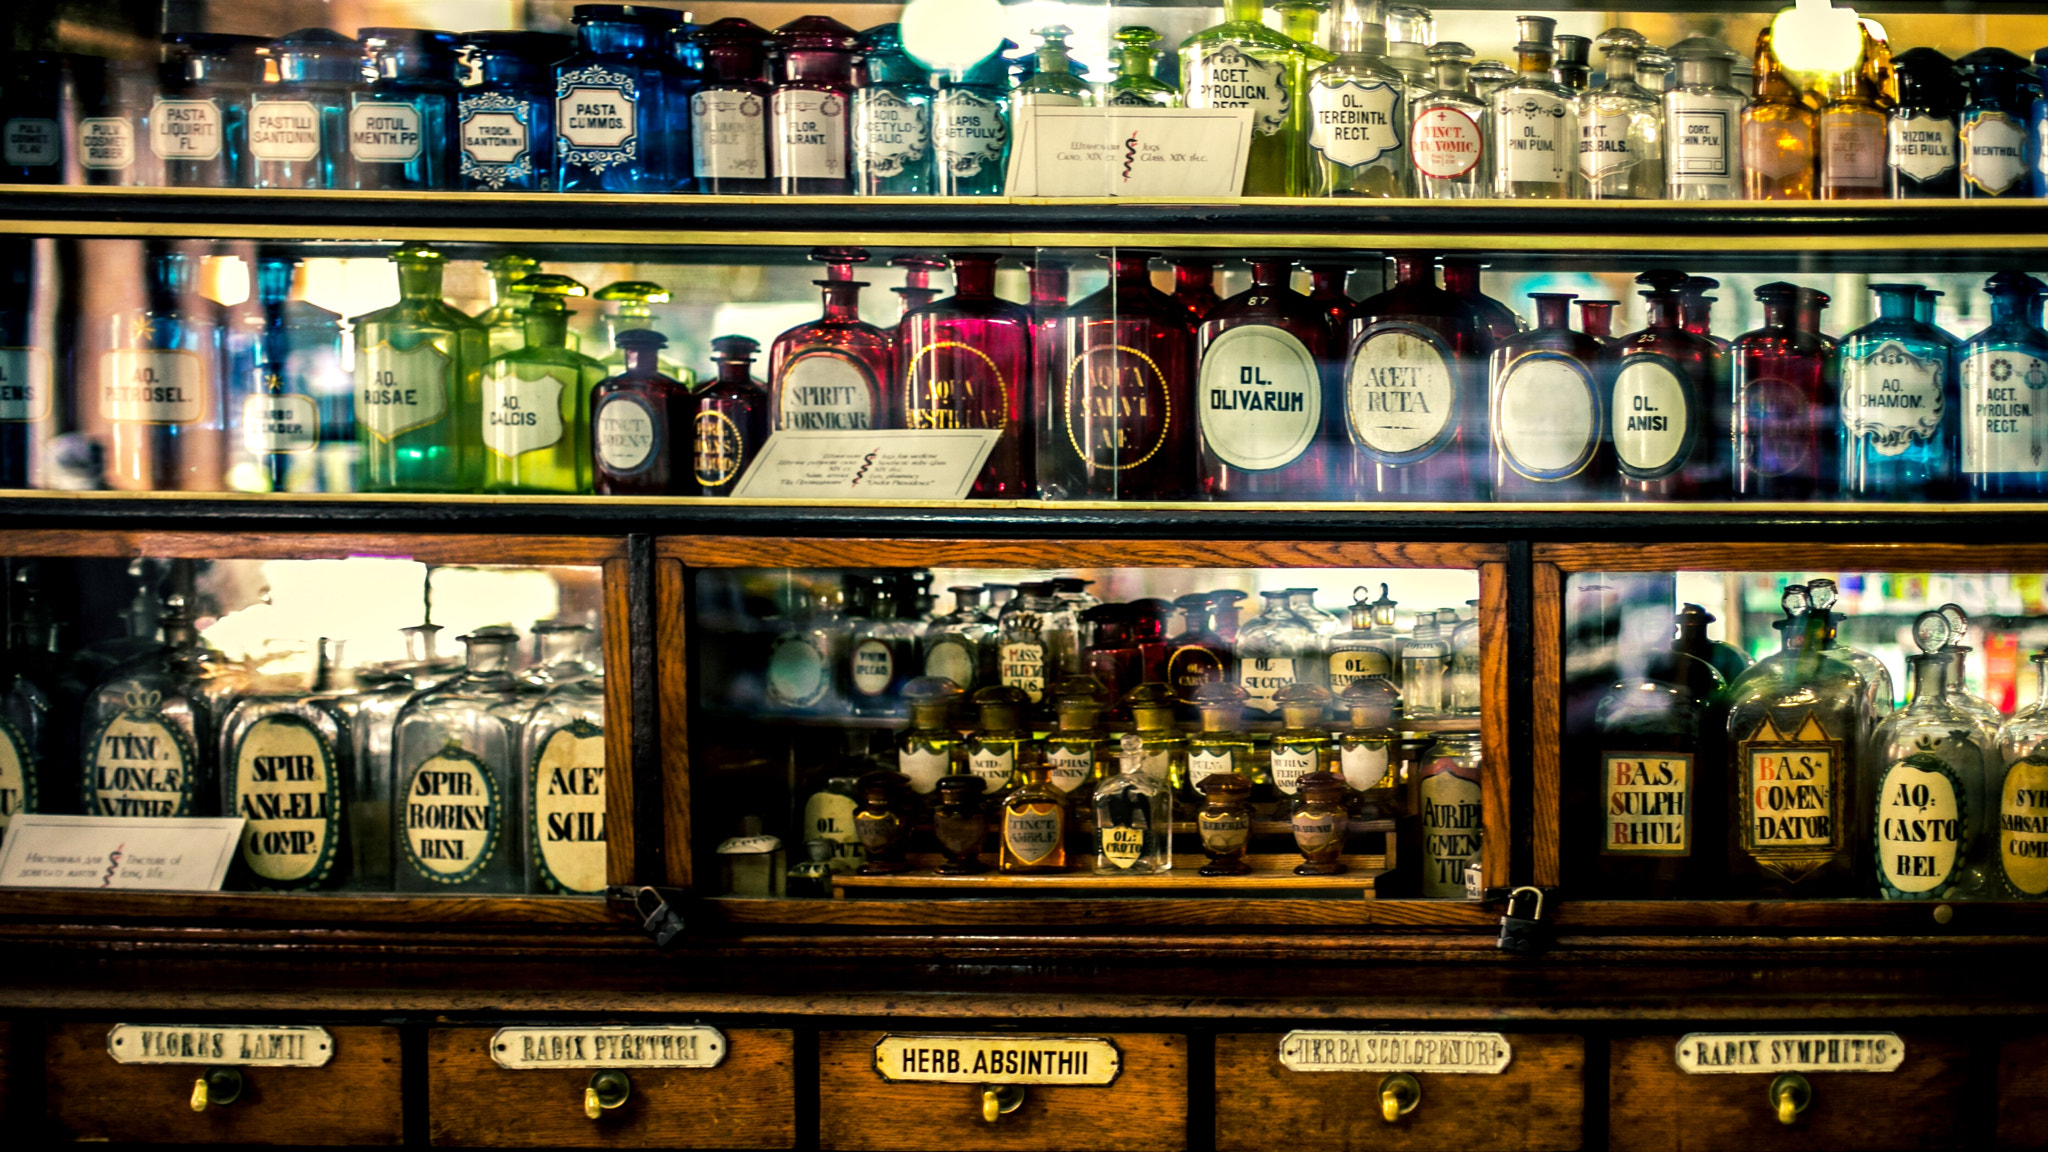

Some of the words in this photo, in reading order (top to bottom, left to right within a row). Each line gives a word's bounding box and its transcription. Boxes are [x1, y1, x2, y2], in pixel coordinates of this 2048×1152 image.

[1213, 69, 1249, 82] ACET.
[1342, 95, 1363, 108] OL.
[167, 109, 205, 121] PASTA
[577, 104, 617, 115] PASTA
[950, 116, 981, 126] LAPIS
[1335, 127, 1370, 140] RECT.
[1524, 126, 1540, 138] OL.
[1902, 131, 1941, 142] RIZOMA
[1248, 297, 1269, 306] 87
[1240, 366, 1272, 385] OL.
[364, 389, 417, 405] ROSAE
[1210, 390, 1303, 411] OLIVARUM
[1987, 388, 2017, 401] ACET.
[1634, 395, 1659, 411] OL.
[491, 412, 536, 426] CALCIS
[1627, 416, 1667, 431] ANISI
[1987, 420, 2018, 433] RECT.
[1610, 791, 1684, 816] SULPH
[1884, 818, 1958, 842] CASTO
[1696, 1040, 1760, 1066] RADIX
[973, 1050, 1088, 1075] ABSINTHII
